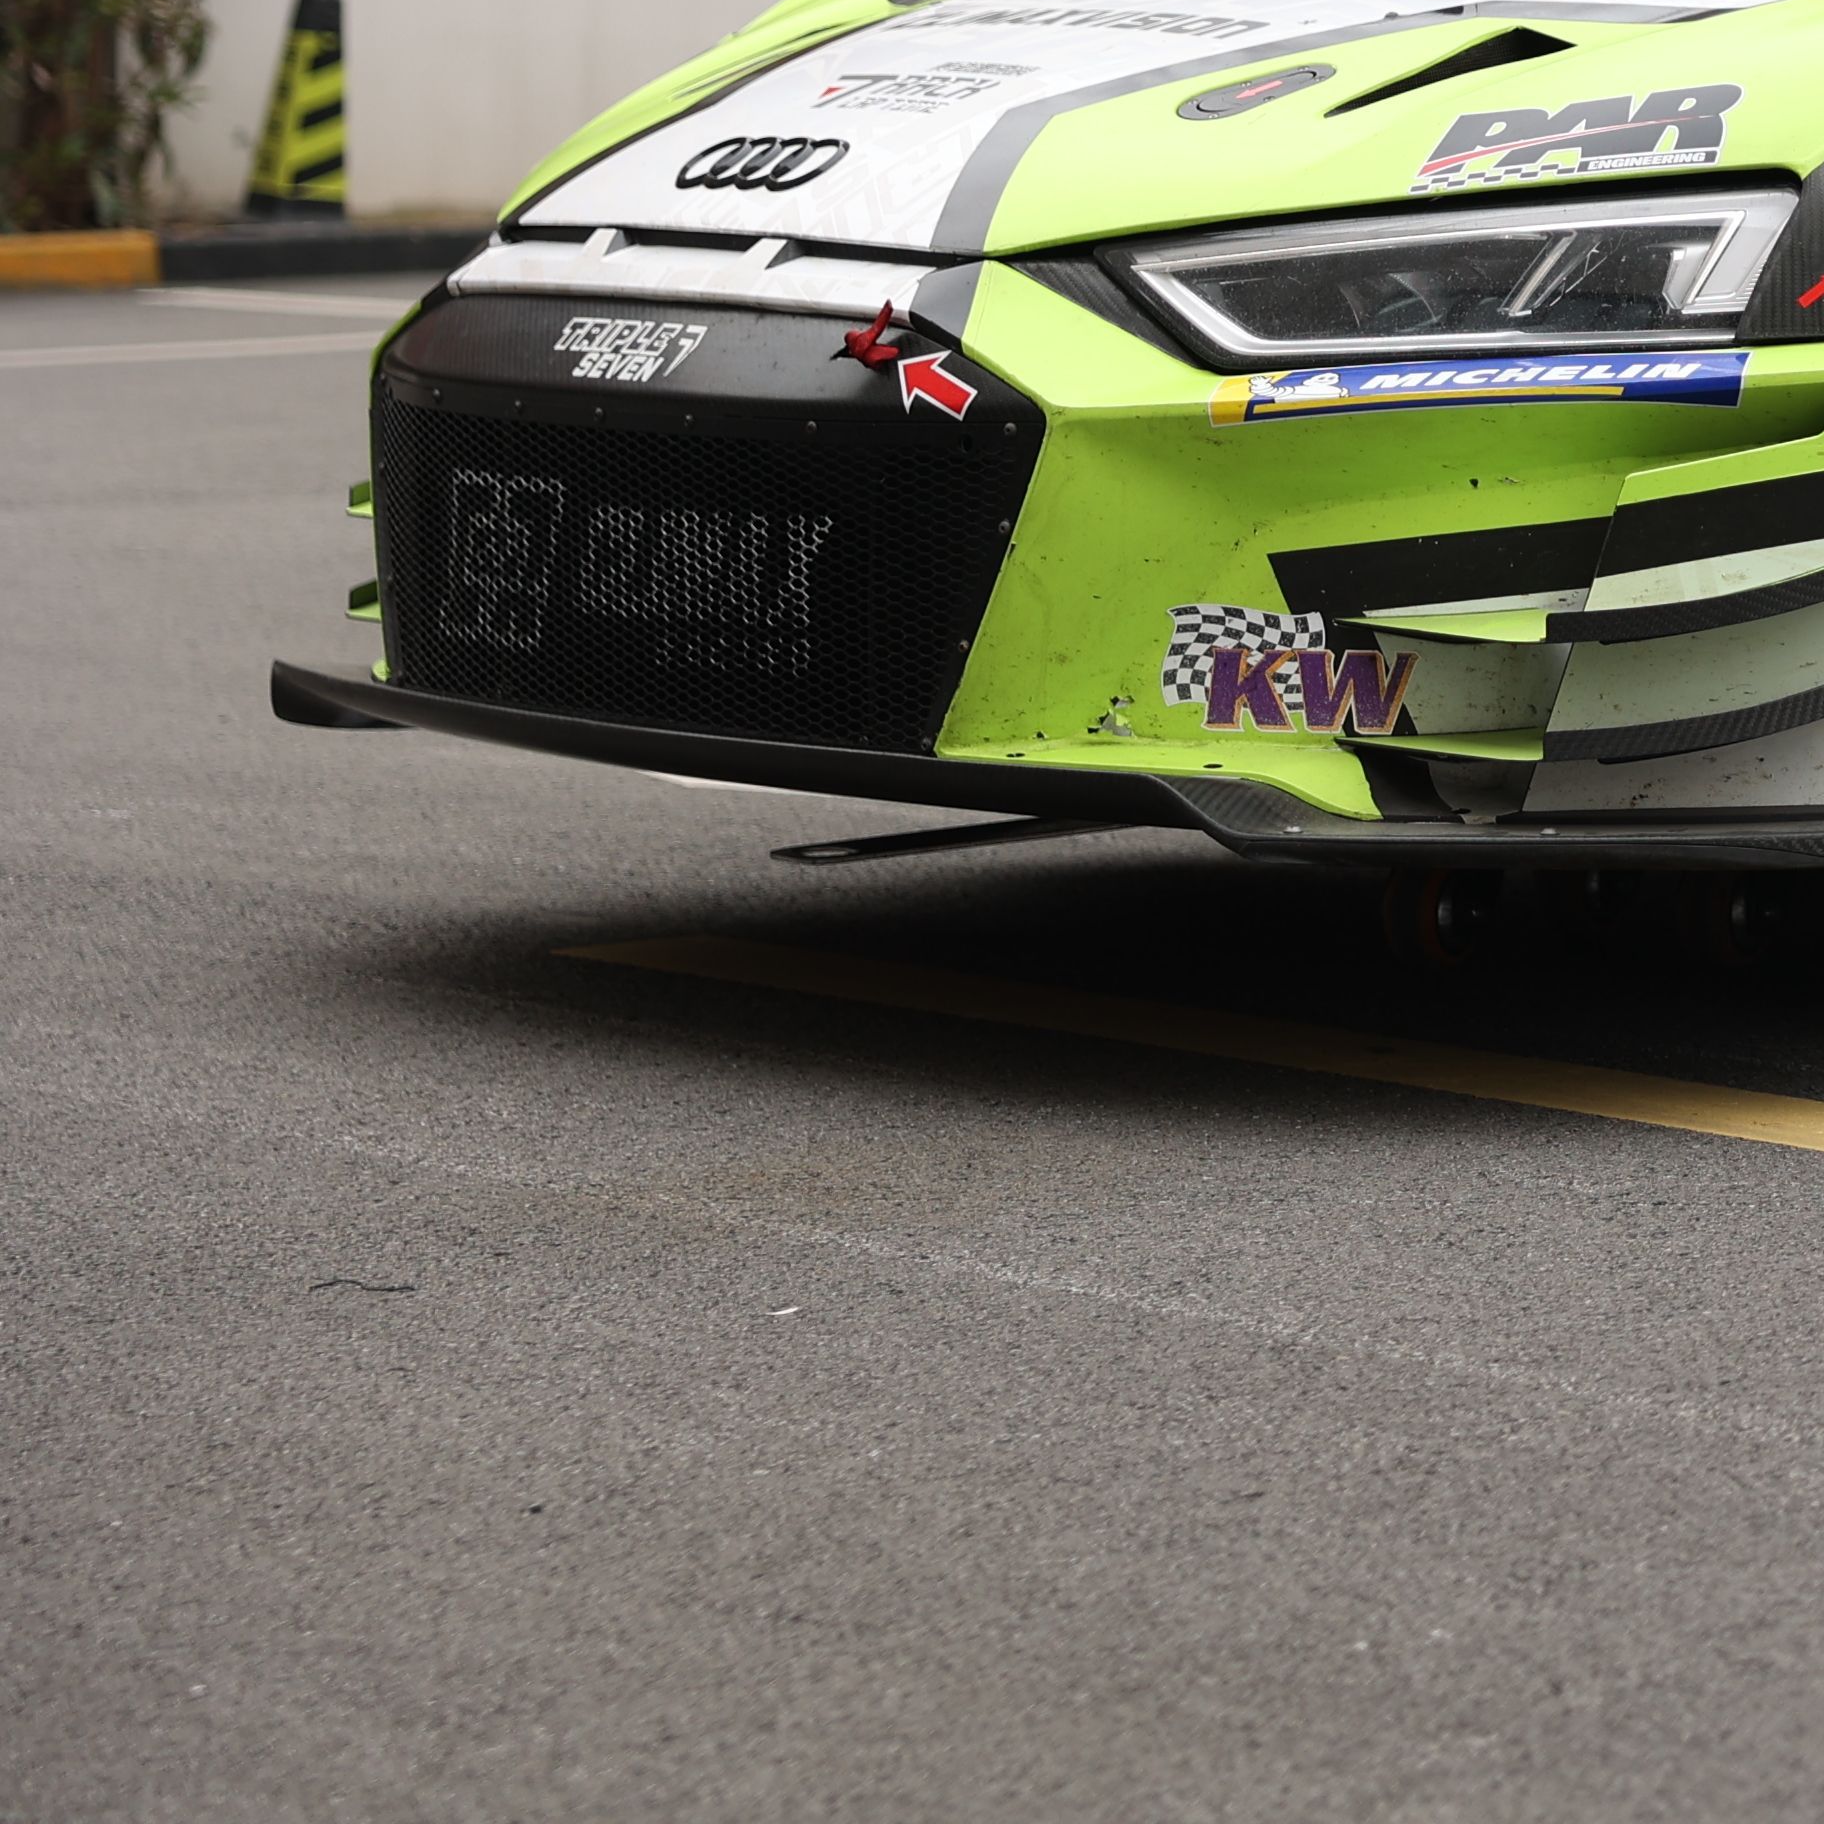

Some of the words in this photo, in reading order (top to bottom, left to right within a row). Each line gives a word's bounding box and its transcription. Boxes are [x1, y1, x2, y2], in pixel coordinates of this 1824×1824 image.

[1424, 84, 1742, 175] PAR
[1587, 151, 1706, 169] ENGINEERING
[554, 317, 684, 352] TRIPLE
[572, 351, 664, 382] SEVEN
[1359, 359, 1706, 393] MICHELIN
[1203, 646, 1419, 735] KW
